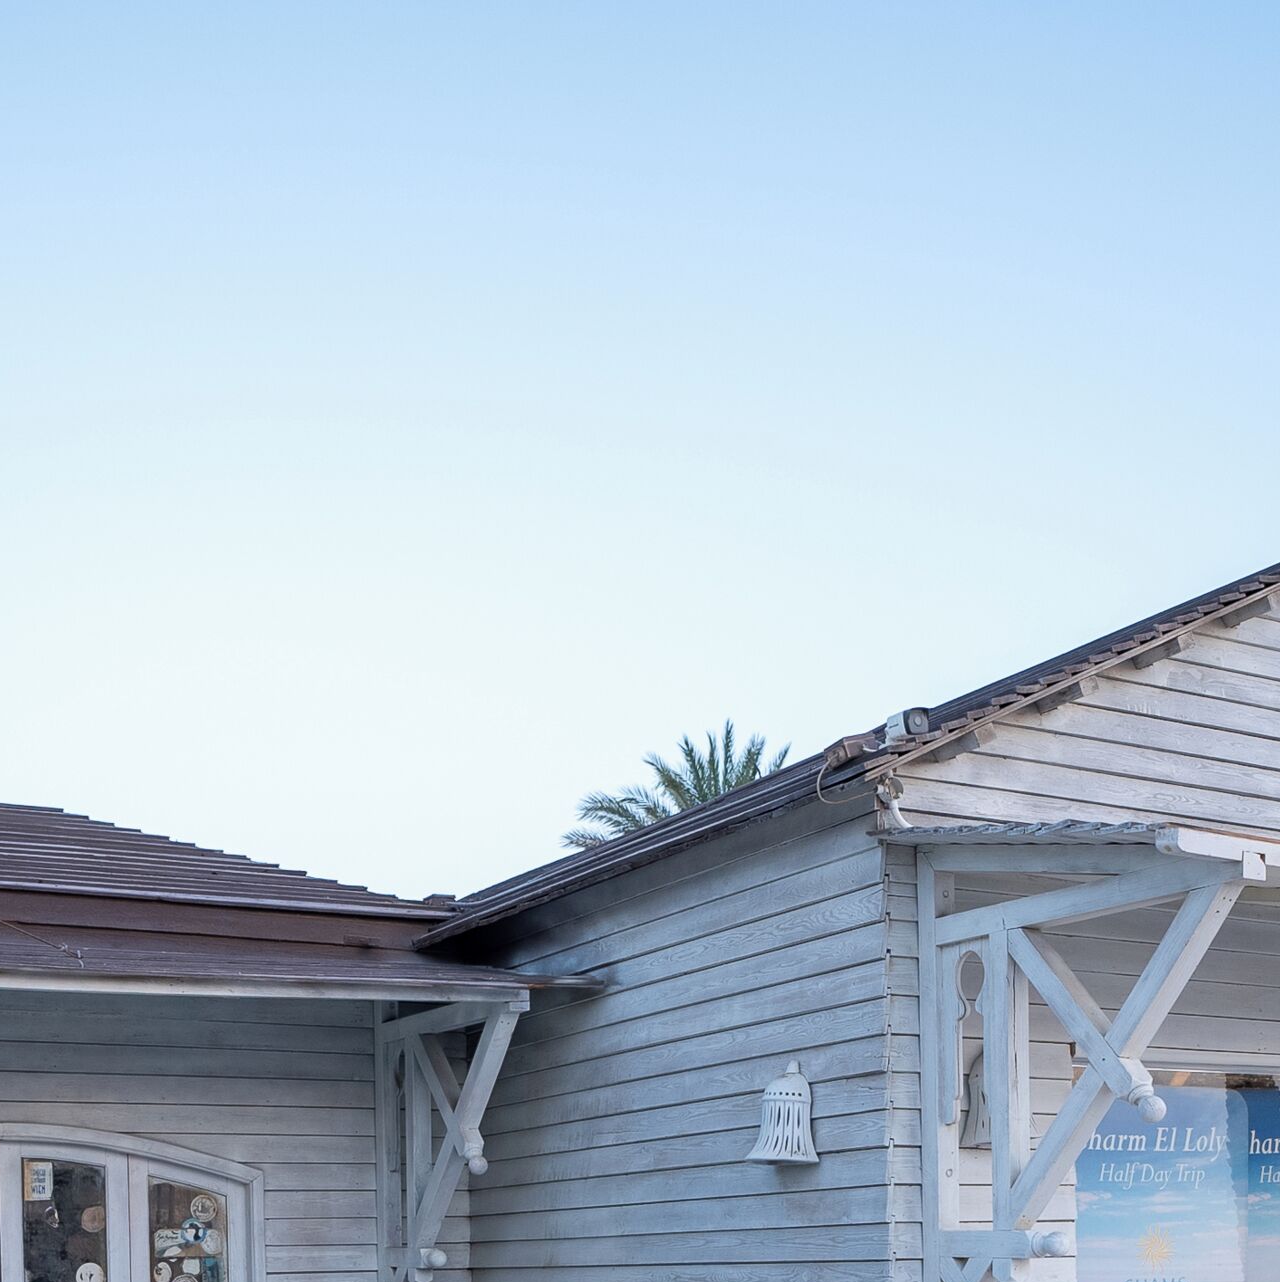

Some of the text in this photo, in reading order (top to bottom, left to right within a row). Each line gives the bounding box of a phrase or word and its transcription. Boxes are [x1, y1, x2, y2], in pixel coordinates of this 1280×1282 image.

[1088, 1126, 1229, 1162] harm El Loly
[1099, 1162, 1207, 1190] Half Day Trip
